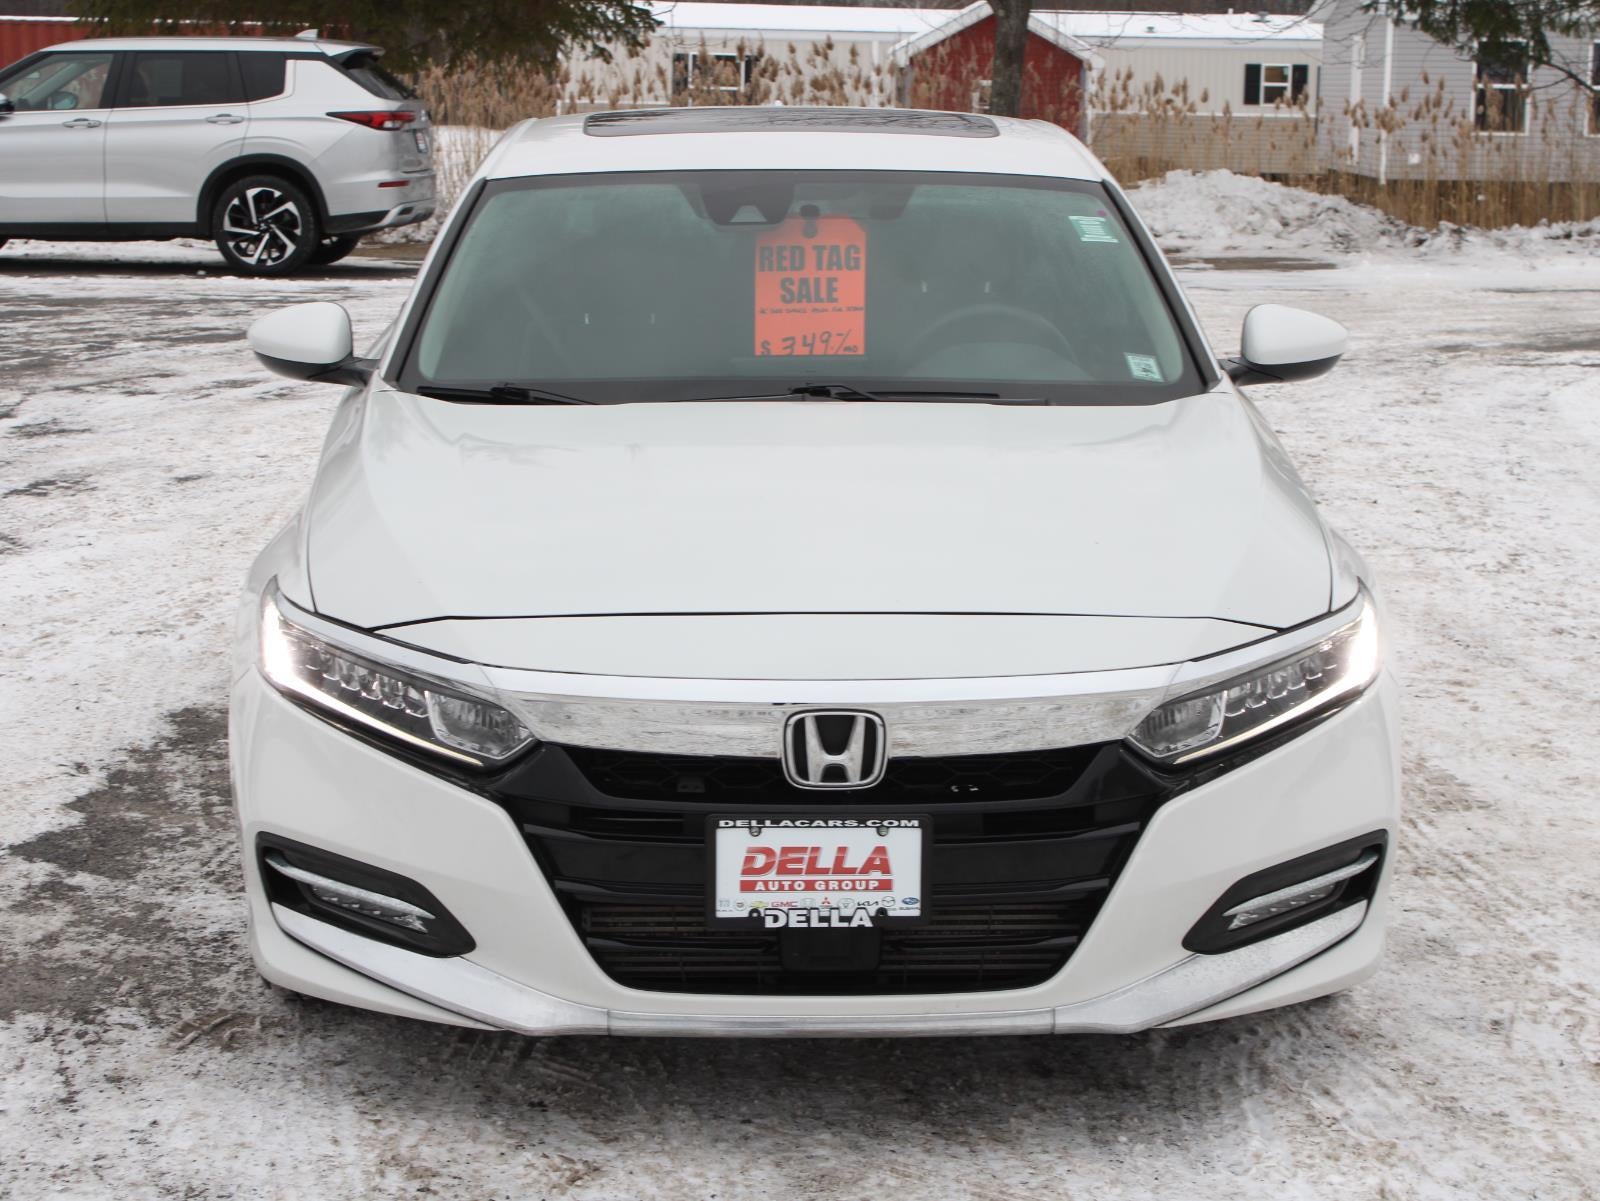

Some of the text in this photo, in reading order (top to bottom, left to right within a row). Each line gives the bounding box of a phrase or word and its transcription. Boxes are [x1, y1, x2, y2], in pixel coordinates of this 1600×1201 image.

[758, 244, 862, 272] RED TAG
[780, 276, 839, 304] SALE
[718, 819, 919, 827] DELLACARS.COM
[740, 845, 892, 876] DELLA
[754, 880, 880, 891] AUTO GROUP
[765, 908, 874, 928] DELLA
